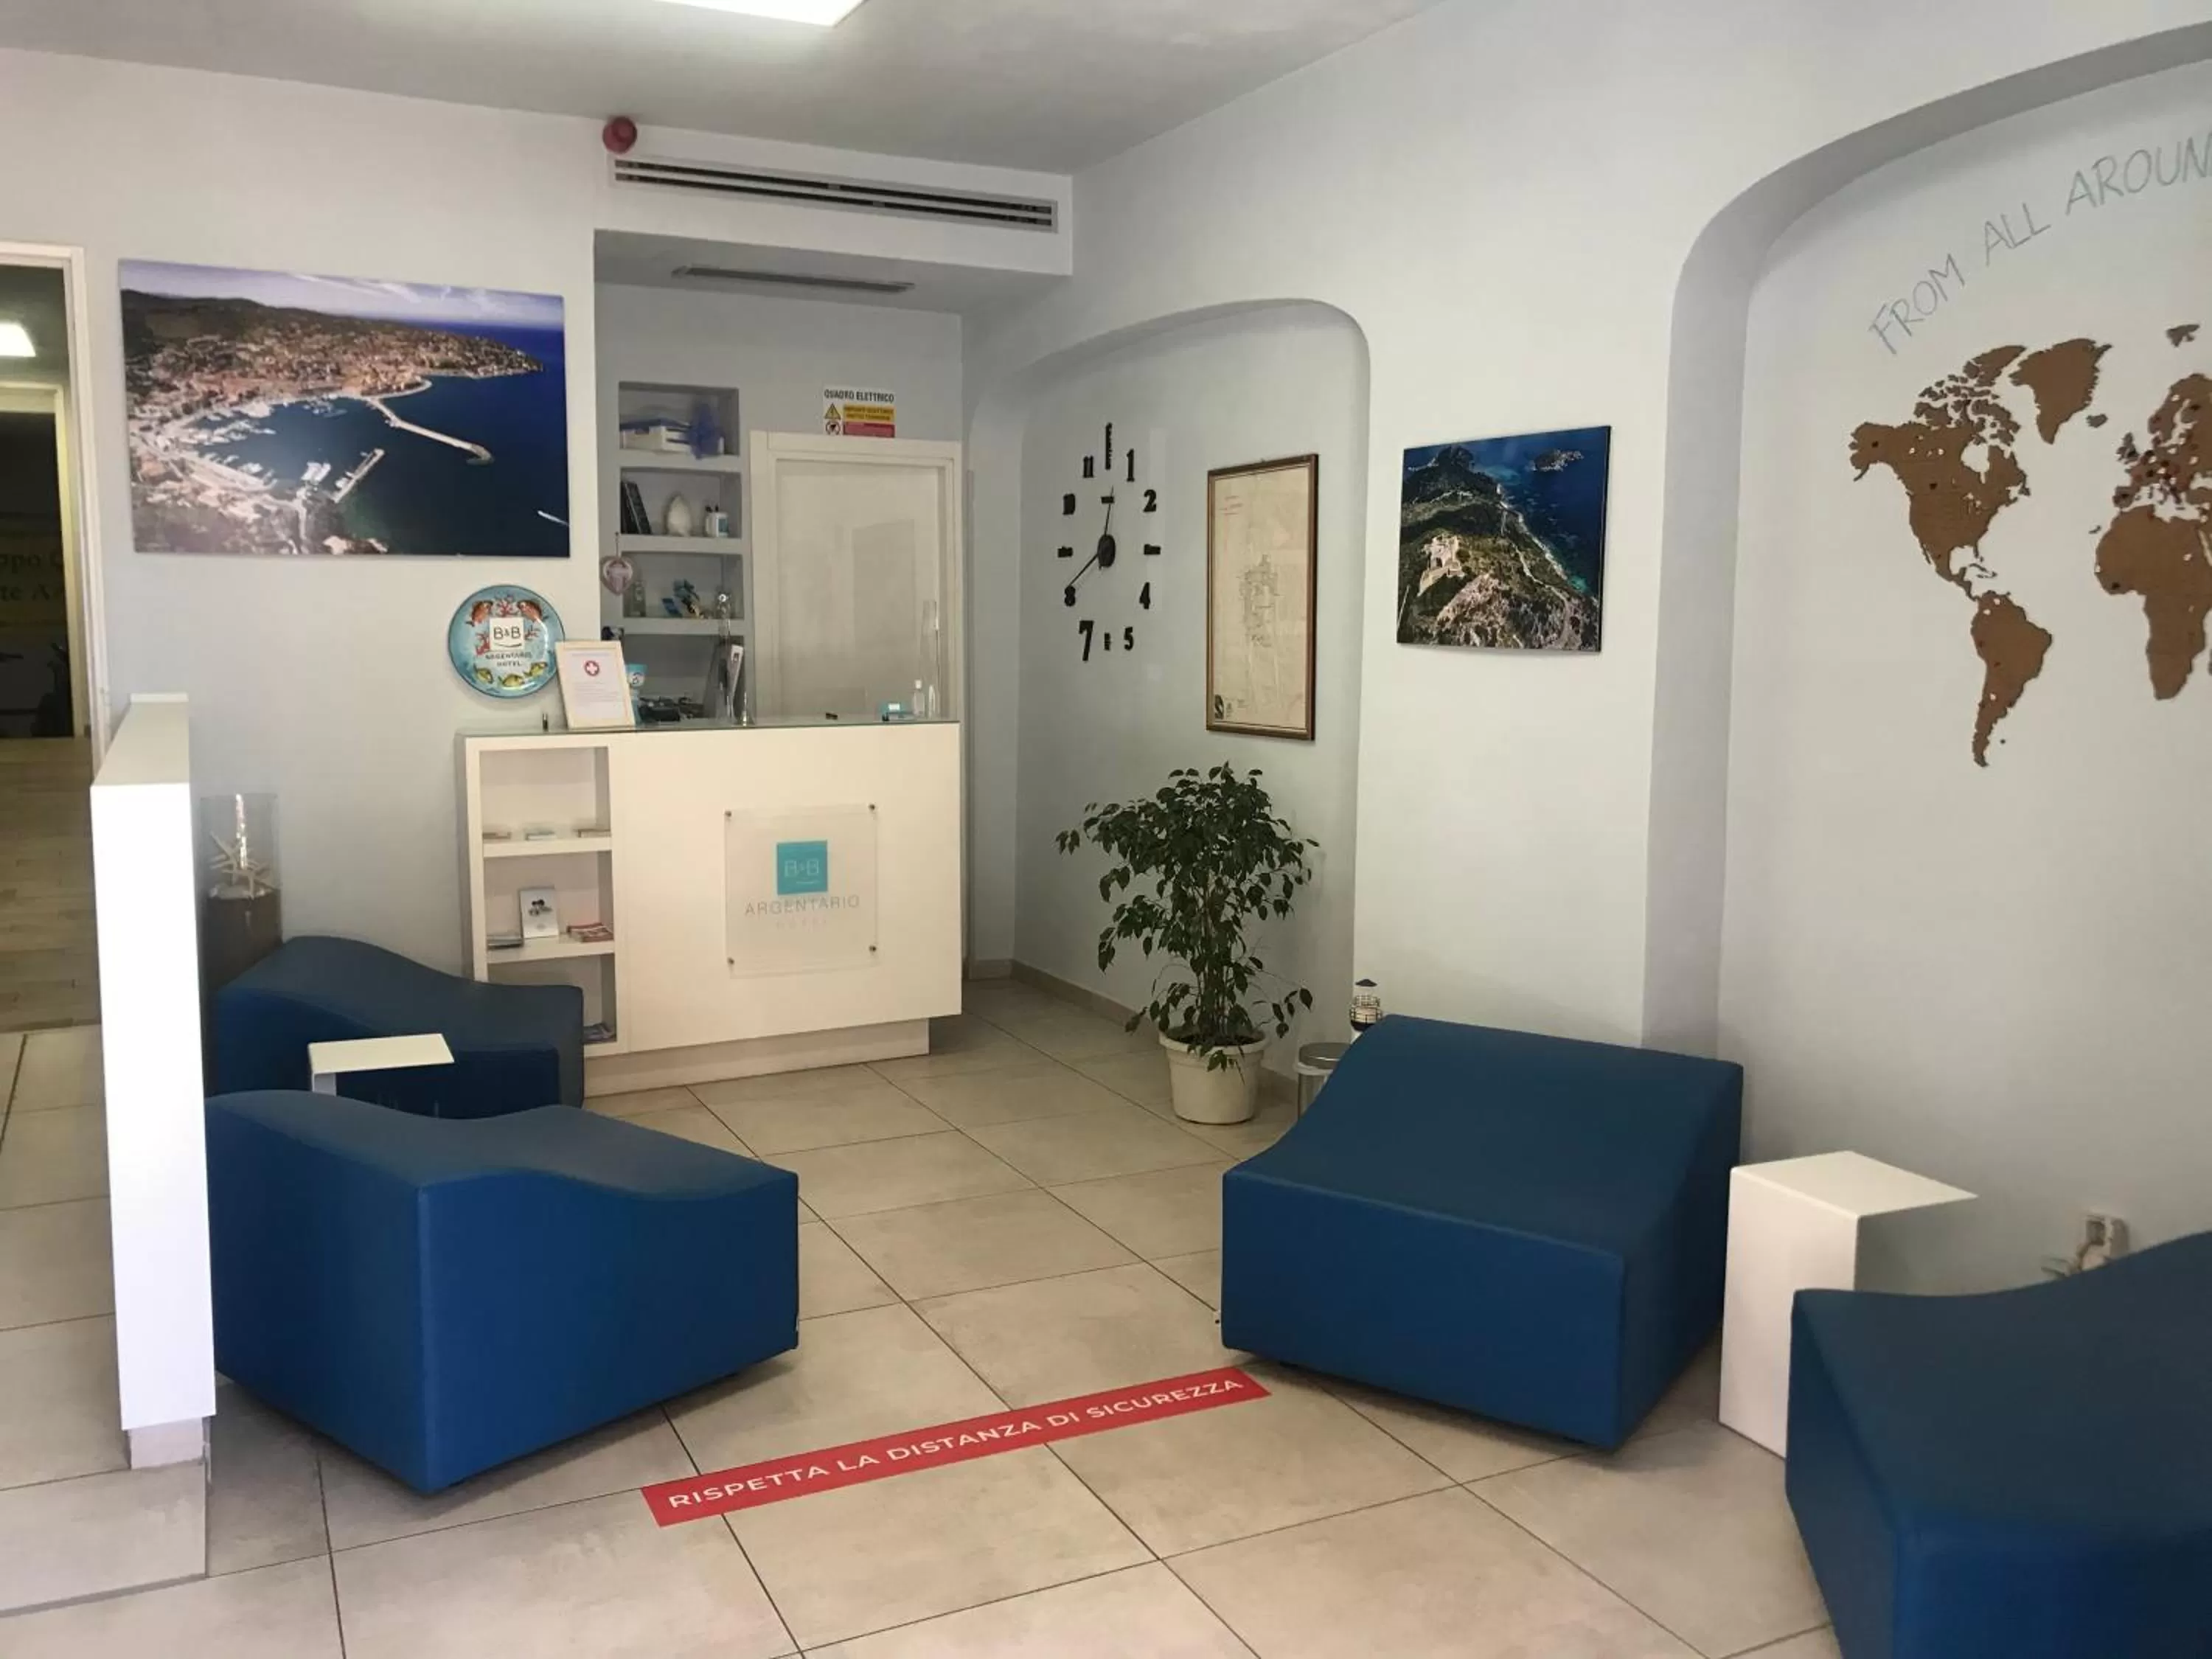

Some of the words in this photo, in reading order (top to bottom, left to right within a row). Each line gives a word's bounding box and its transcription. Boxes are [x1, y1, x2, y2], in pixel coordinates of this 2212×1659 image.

[1868, 253, 1966, 355] FROM
[1983, 202, 2051, 266] ALL
[2065, 131, 2212, 216] AROUN
[1143, 489, 1157, 512] 2
[1064, 585, 1076, 607] 8
[1139, 582, 1150, 611] 4
[493, 626, 521, 640] B&B
[1079, 620, 1094, 661] 7
[1124, 626, 1134, 652] 5
[744, 894, 860, 917] ARGENTARIO
[667, 1464, 830, 1509] RISPETTA
[836, 1454, 881, 1472] LA
[886, 1420, 1042, 1461] DISTANZA
[1046, 1411, 1081, 1428] DI
[1085, 1379, 1245, 1419] SICUREZZA
